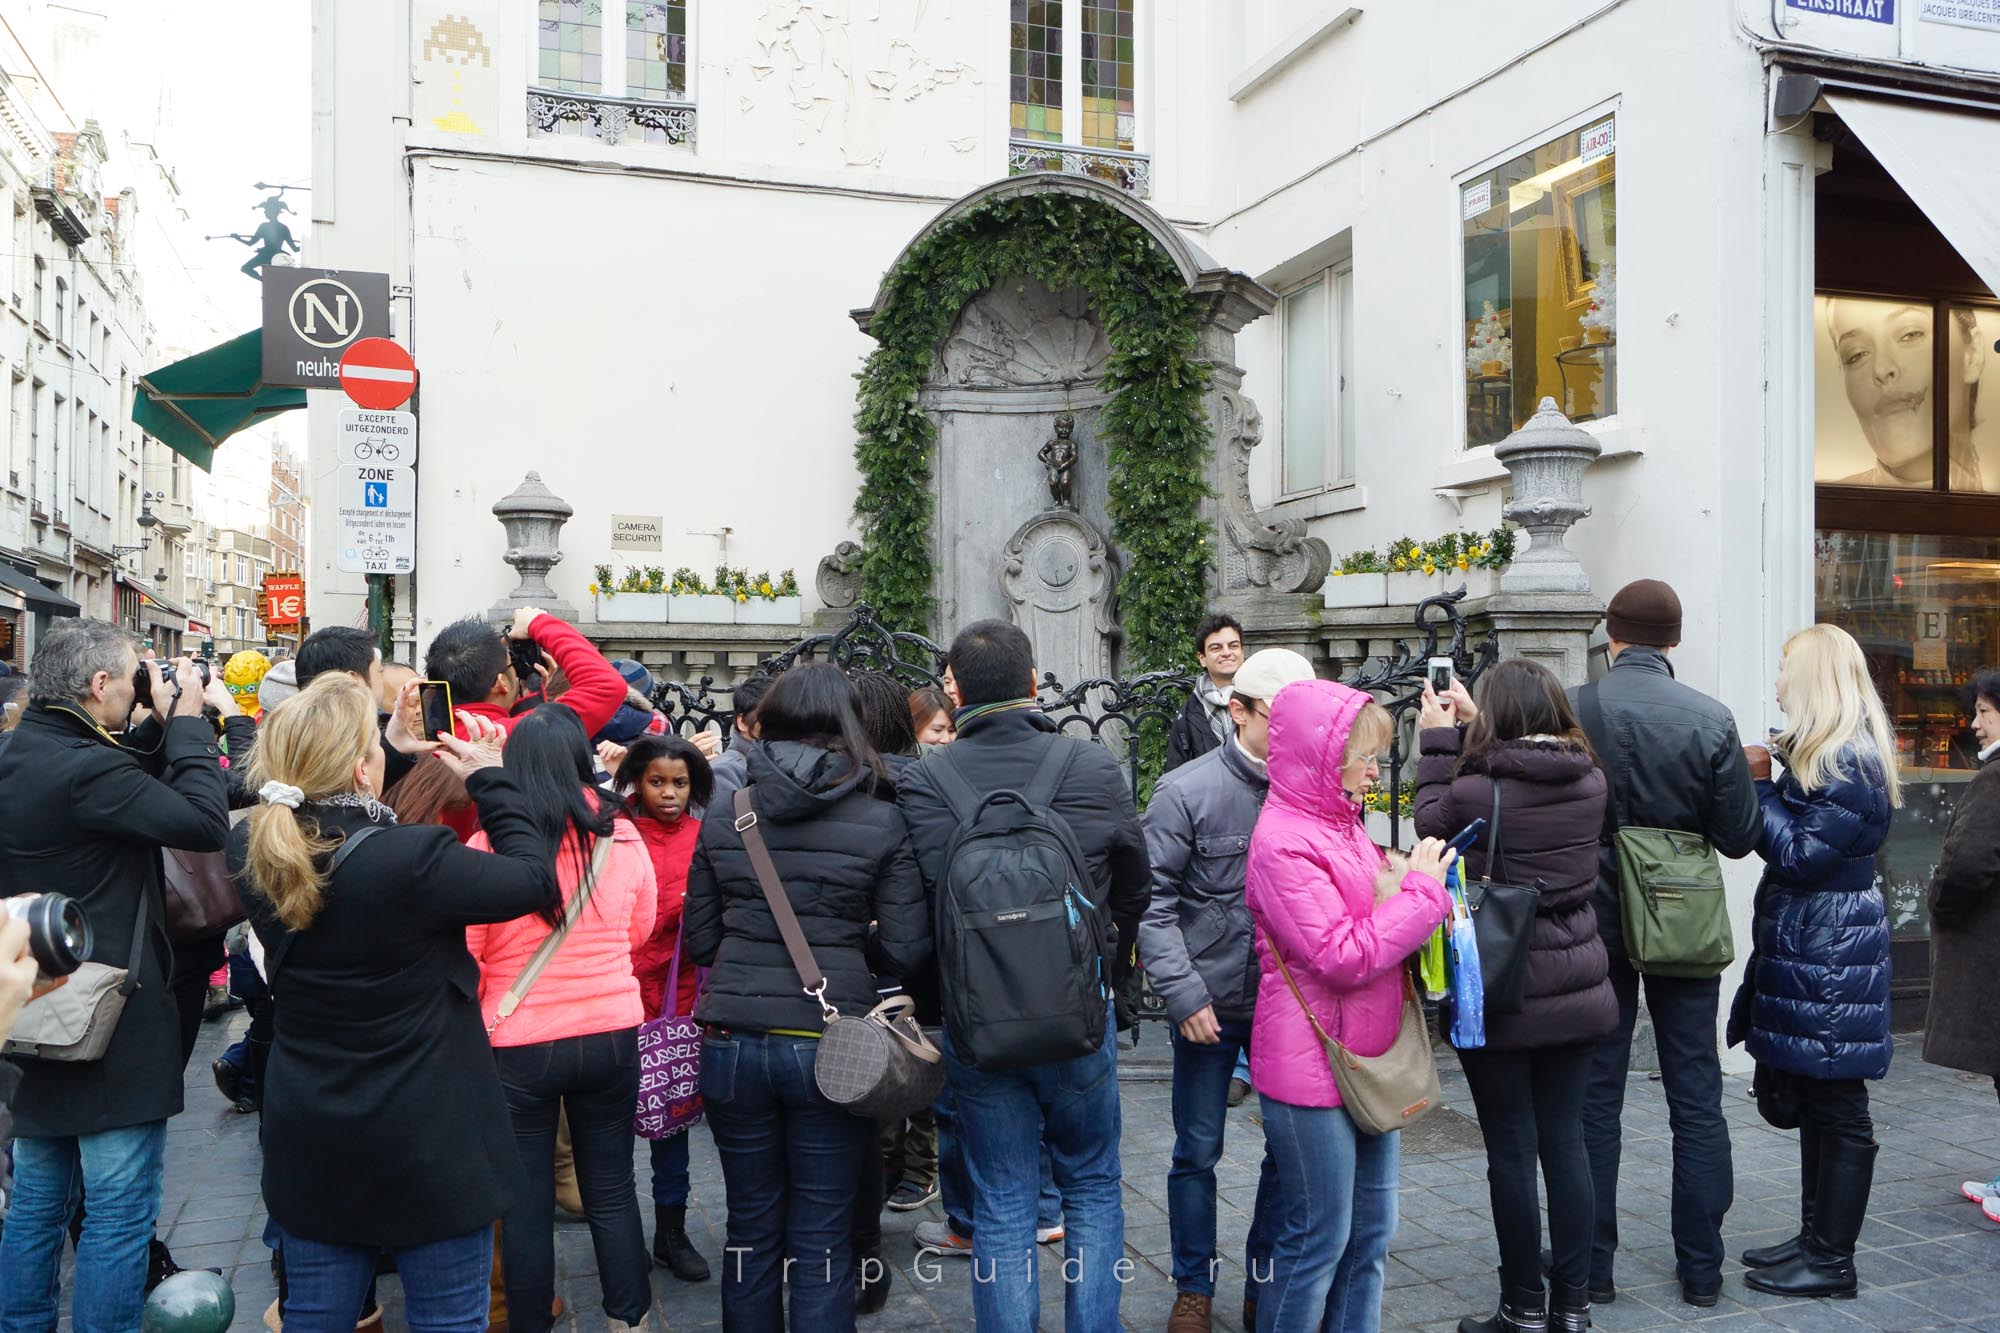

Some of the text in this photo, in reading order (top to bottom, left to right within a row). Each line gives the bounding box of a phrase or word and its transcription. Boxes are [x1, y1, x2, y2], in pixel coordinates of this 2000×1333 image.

[1922, 3, 1956, 18] JACQUES
[303, 292, 349, 336] N
[358, 414, 396, 424] EXCEPTE
[345, 424, 409, 435] UITGEZONDERD
[358, 468, 394, 481] ZONE
[617, 522, 656, 532] CAMERA
[368, 533, 374, 542] 6
[385, 534, 395, 543] 11h
[613, 532, 661, 543] SECURITY!
[364, 561, 387, 570] TAXI
[268, 583, 300, 591] WAFFLE
[268, 595, 301, 619] 1€
